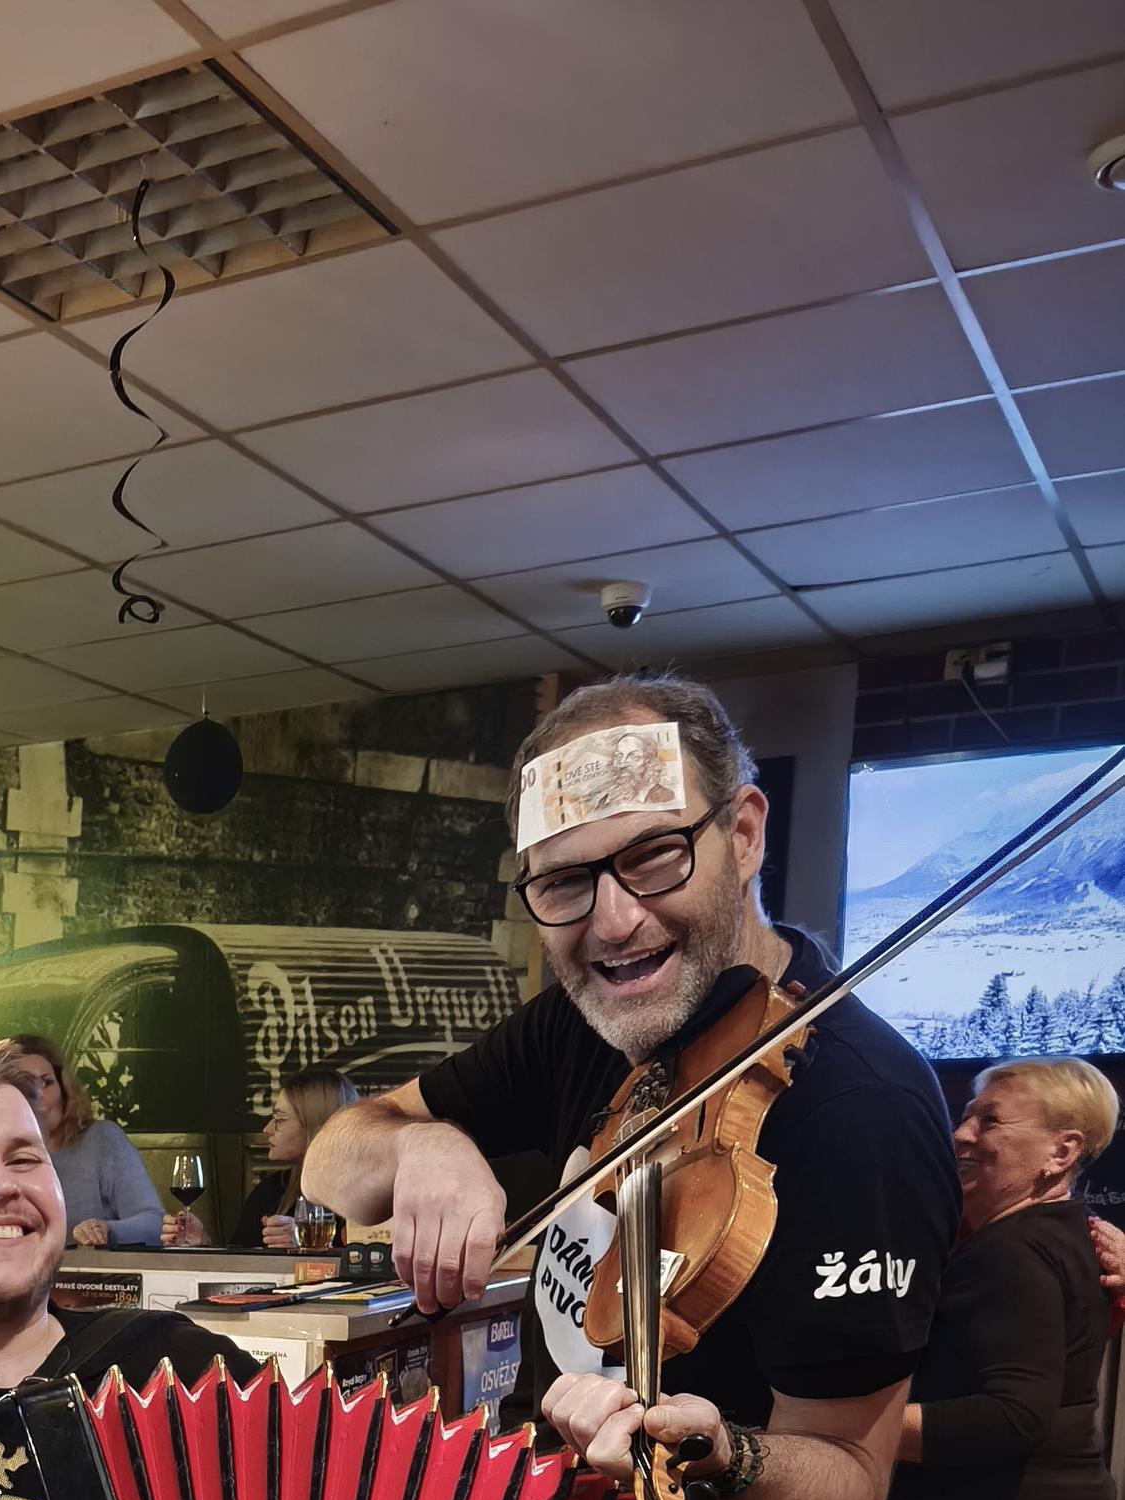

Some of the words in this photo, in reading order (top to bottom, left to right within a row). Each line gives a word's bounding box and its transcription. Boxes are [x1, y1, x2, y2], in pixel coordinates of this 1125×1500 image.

[76, 1283, 104, 1291] OVOCNÉ
[104, 1284, 139, 1292] DESTILÁTY
[114, 1291, 139, 1304] 1894
